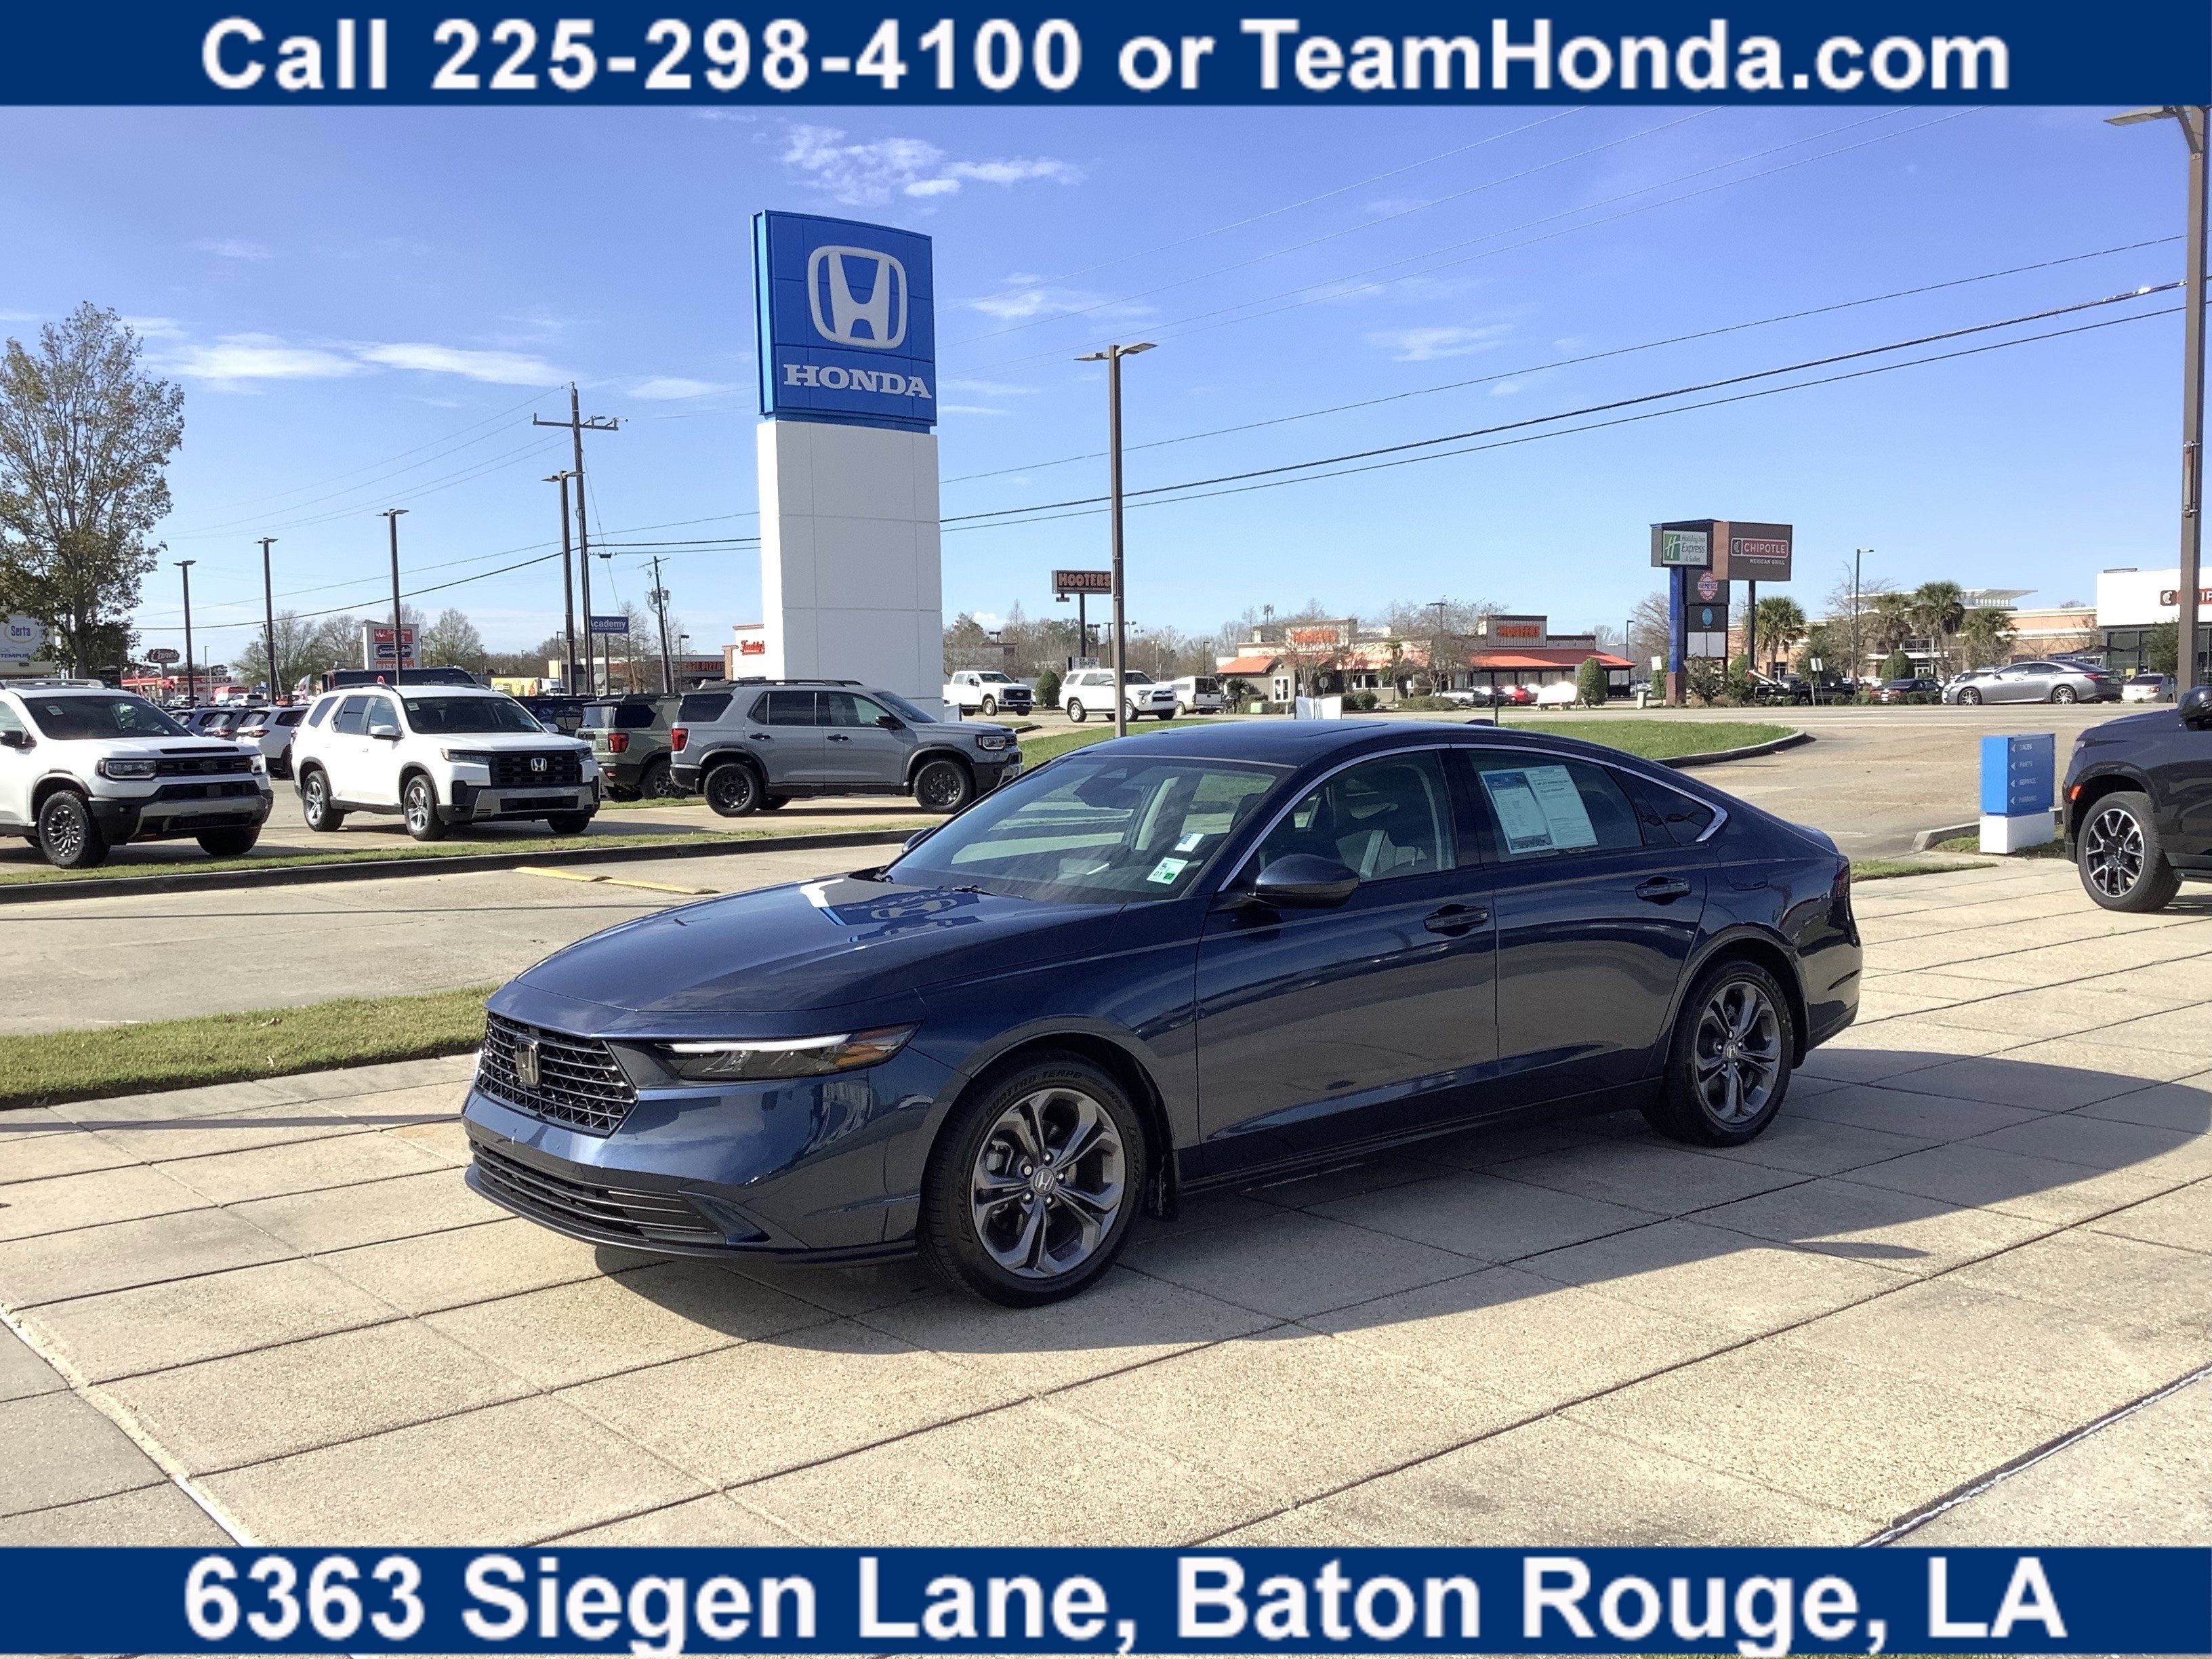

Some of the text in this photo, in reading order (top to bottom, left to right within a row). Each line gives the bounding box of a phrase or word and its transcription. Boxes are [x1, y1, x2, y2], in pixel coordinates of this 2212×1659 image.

[783, 364, 933, 398] HONDA
[1681, 542, 1705, 554] Express
[1744, 543, 1786, 554] CHIPOTLE
[1058, 573, 1111, 587] HOOTERS
[11, 626, 31, 636] Serta
